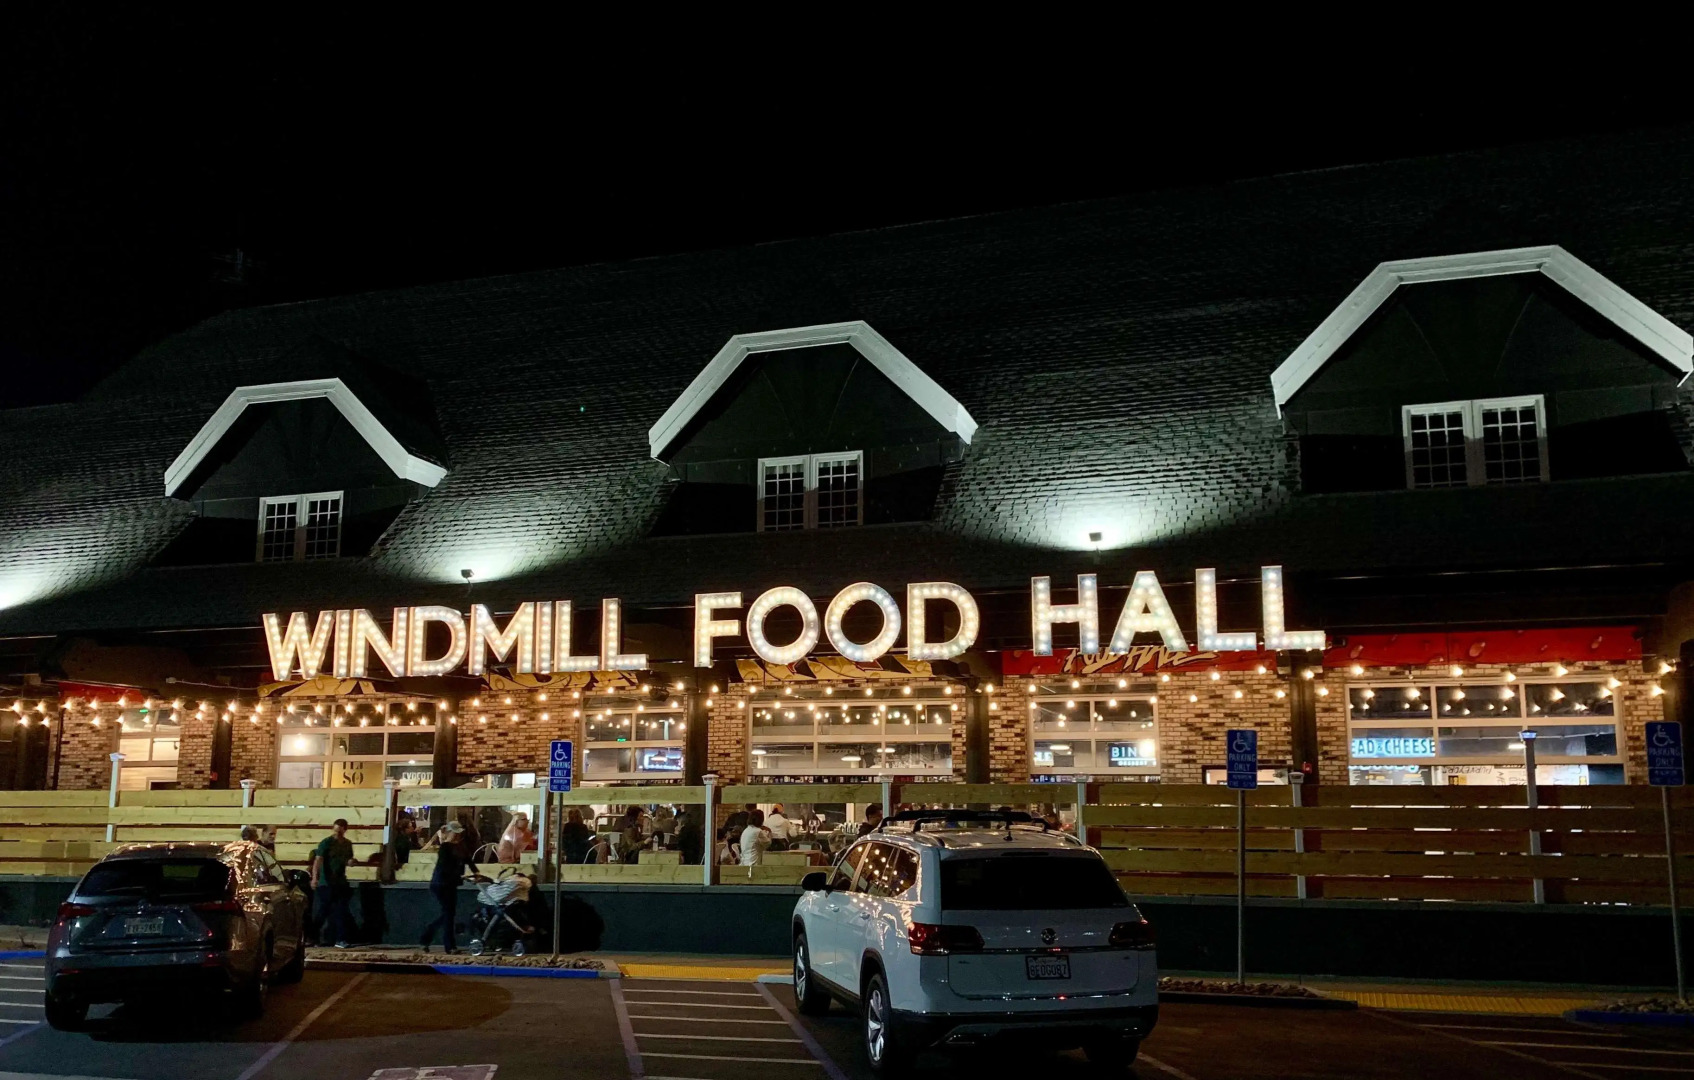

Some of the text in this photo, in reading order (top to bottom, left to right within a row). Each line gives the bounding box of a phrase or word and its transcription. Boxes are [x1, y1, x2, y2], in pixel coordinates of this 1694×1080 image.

[262, 565, 1326, 680] WINDMILL FOOD HALL
[1385, 738, 1436, 754] CHEESE
[1111, 747, 1145, 758] BIN
[1229, 753, 1256, 762] PARKING
[551, 761, 571, 769] PARKING
[1233, 762, 1250, 771] ONLY
[554, 769, 567, 777] ONLY
